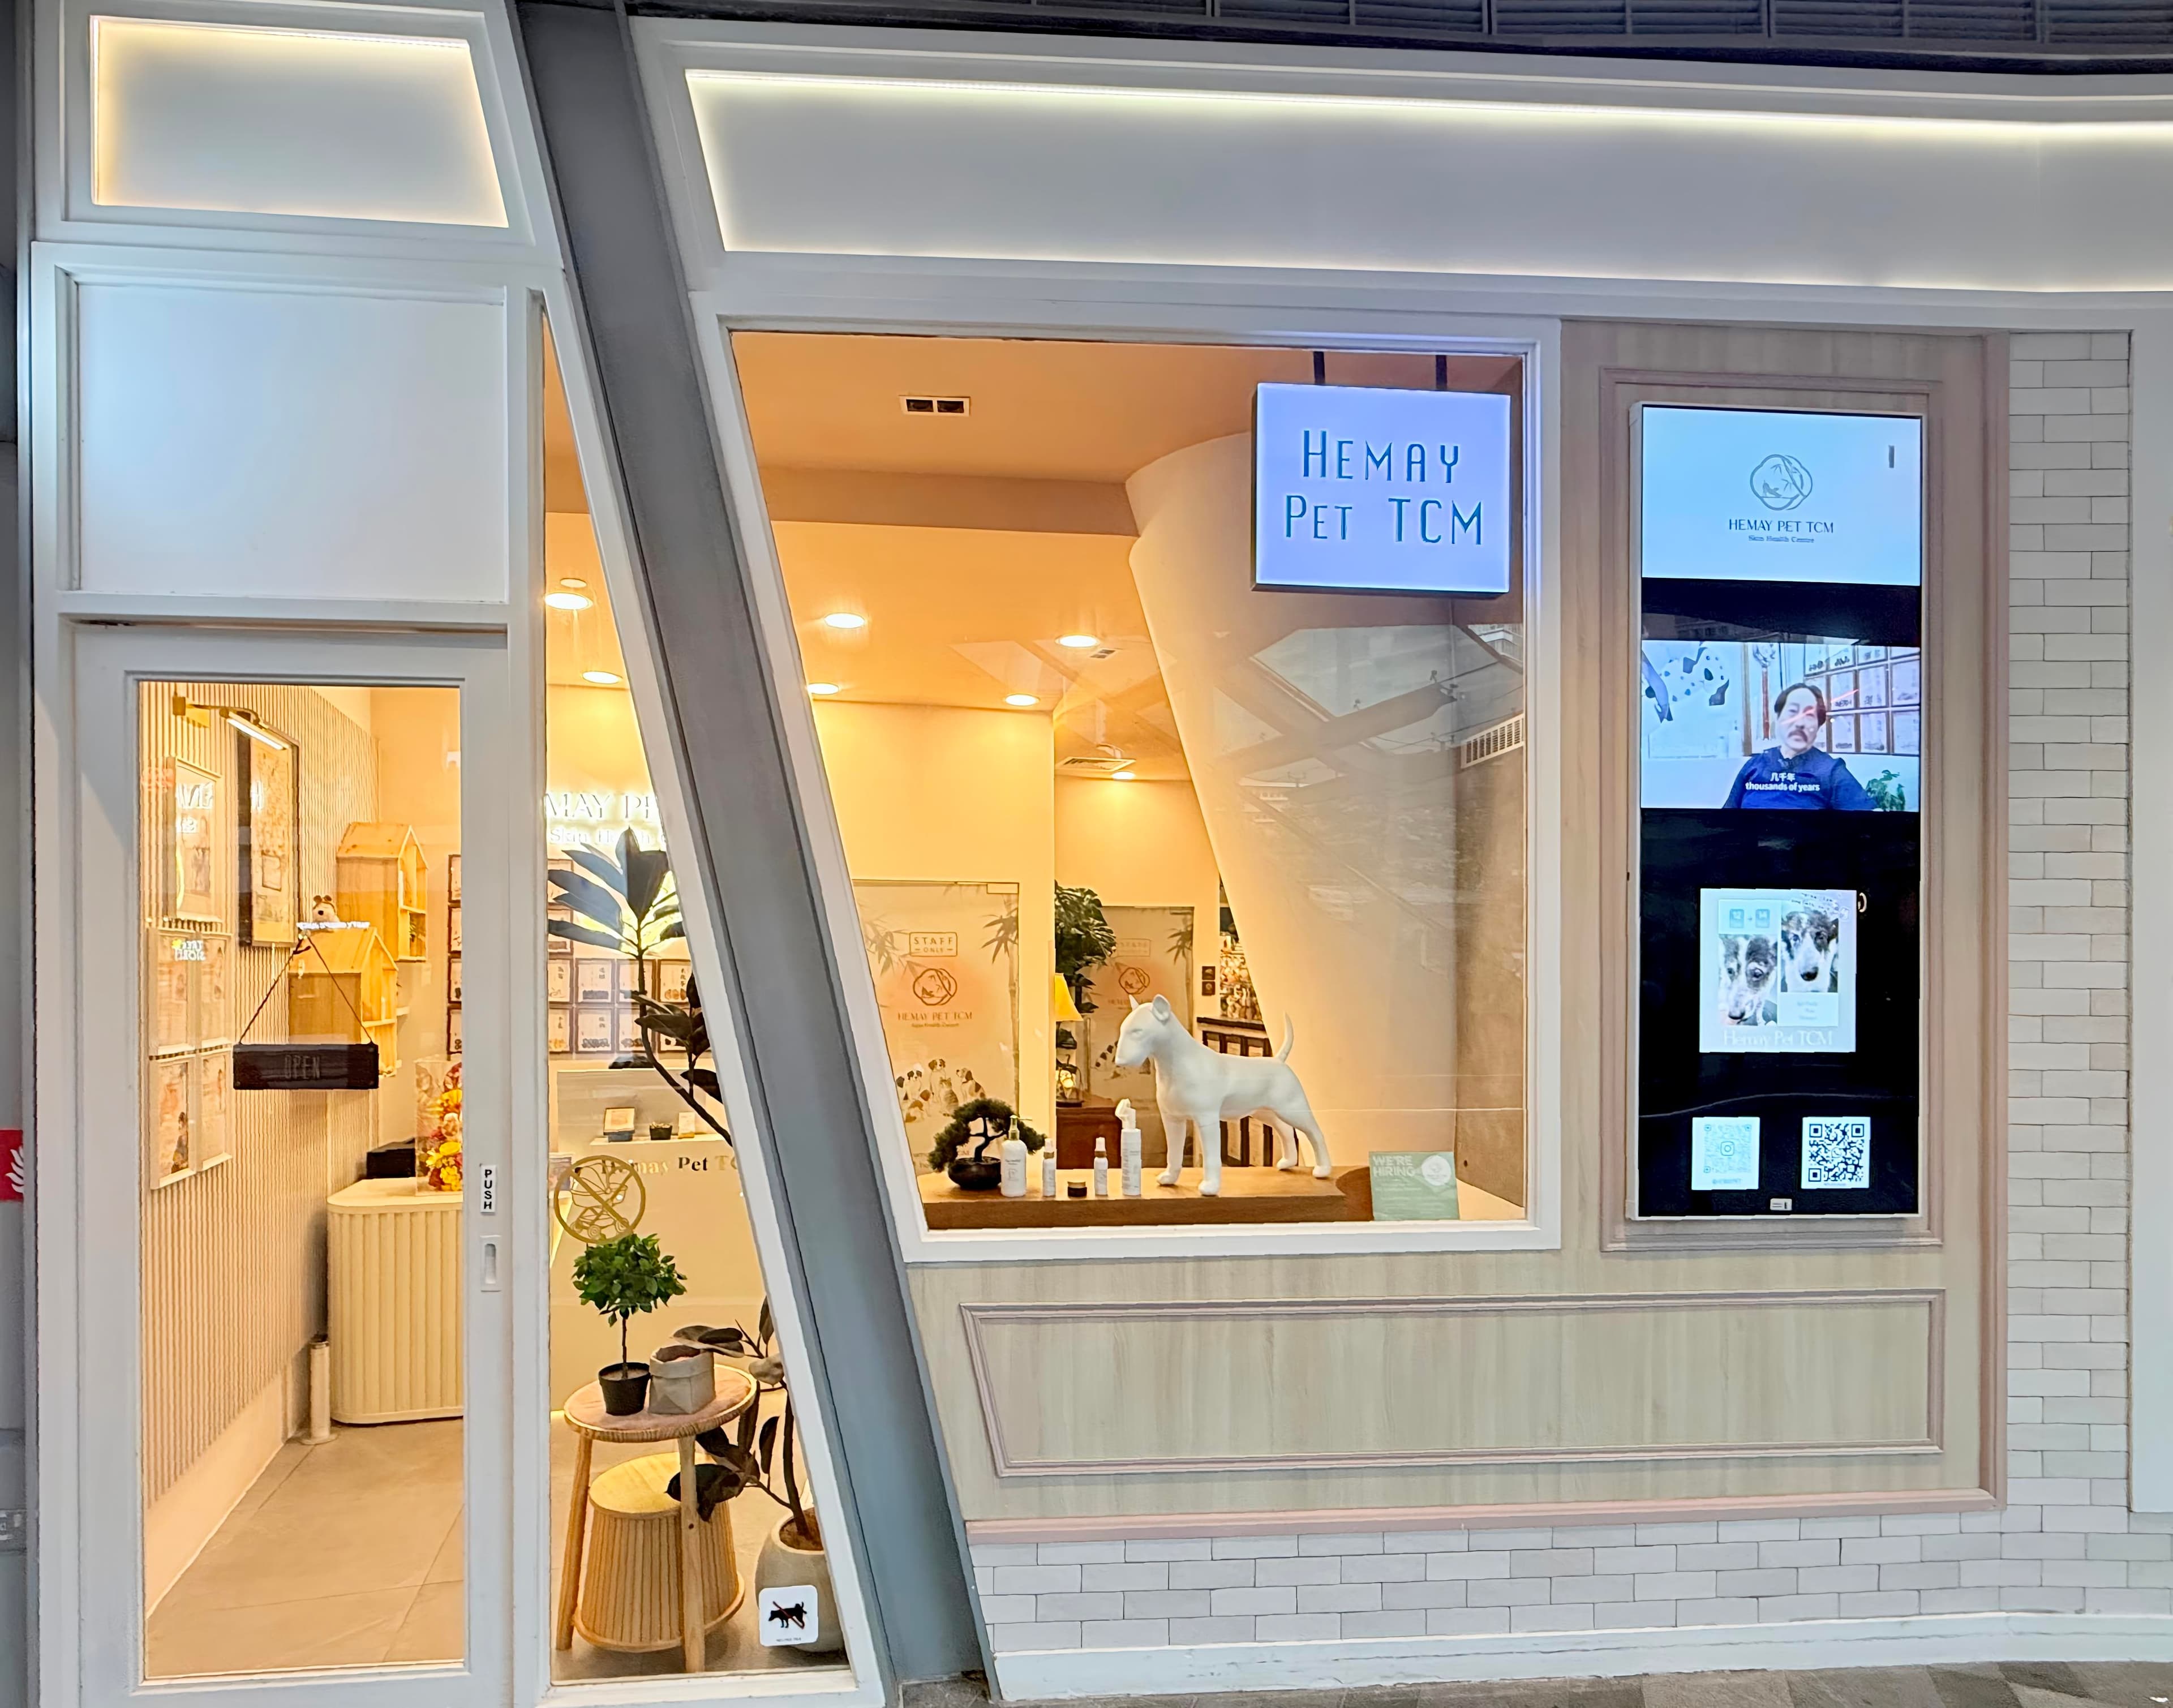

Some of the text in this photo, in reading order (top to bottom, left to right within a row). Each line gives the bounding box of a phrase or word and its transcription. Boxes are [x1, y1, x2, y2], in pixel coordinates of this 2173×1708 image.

[1303, 430, 1459, 483] HEMAY
[1285, 495, 1482, 545] PET TCM
[1729, 518, 1834, 534] HEMAY PET TCM
[1745, 782, 1820, 793] thousands of years
[914, 937, 953, 945] STAFF
[1797, 1030, 1833, 1046] TCM
[285, 1054, 321, 1080] OPEN
[678, 1157, 708, 1171] Pet
[484, 1169, 492, 1210] PUSH
